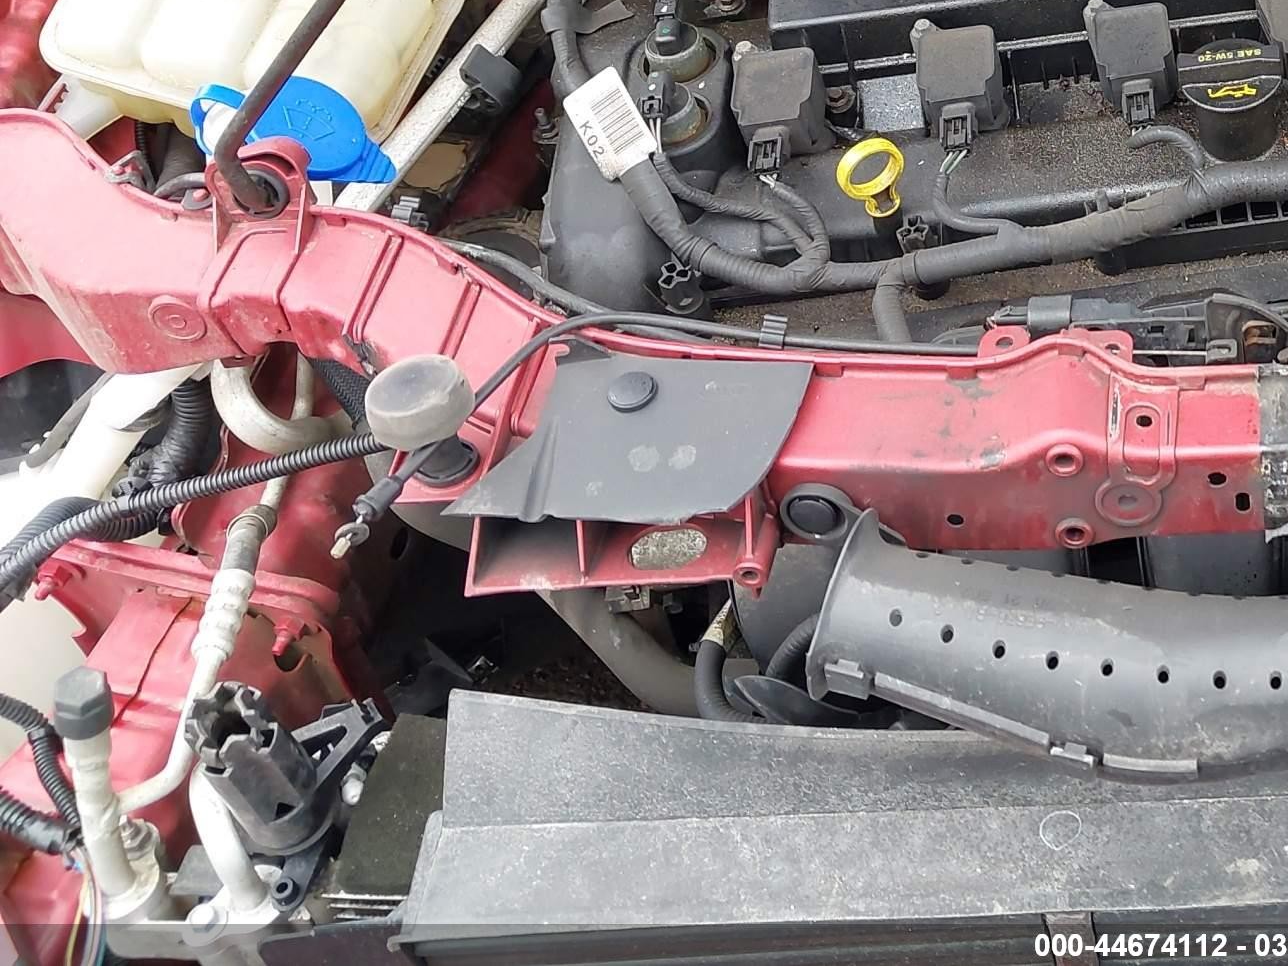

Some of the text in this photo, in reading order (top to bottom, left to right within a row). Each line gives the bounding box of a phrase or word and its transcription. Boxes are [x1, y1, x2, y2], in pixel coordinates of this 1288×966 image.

[1198, 48, 1262, 62] SAE 5W-20
[578, 120, 605, 160] K02
